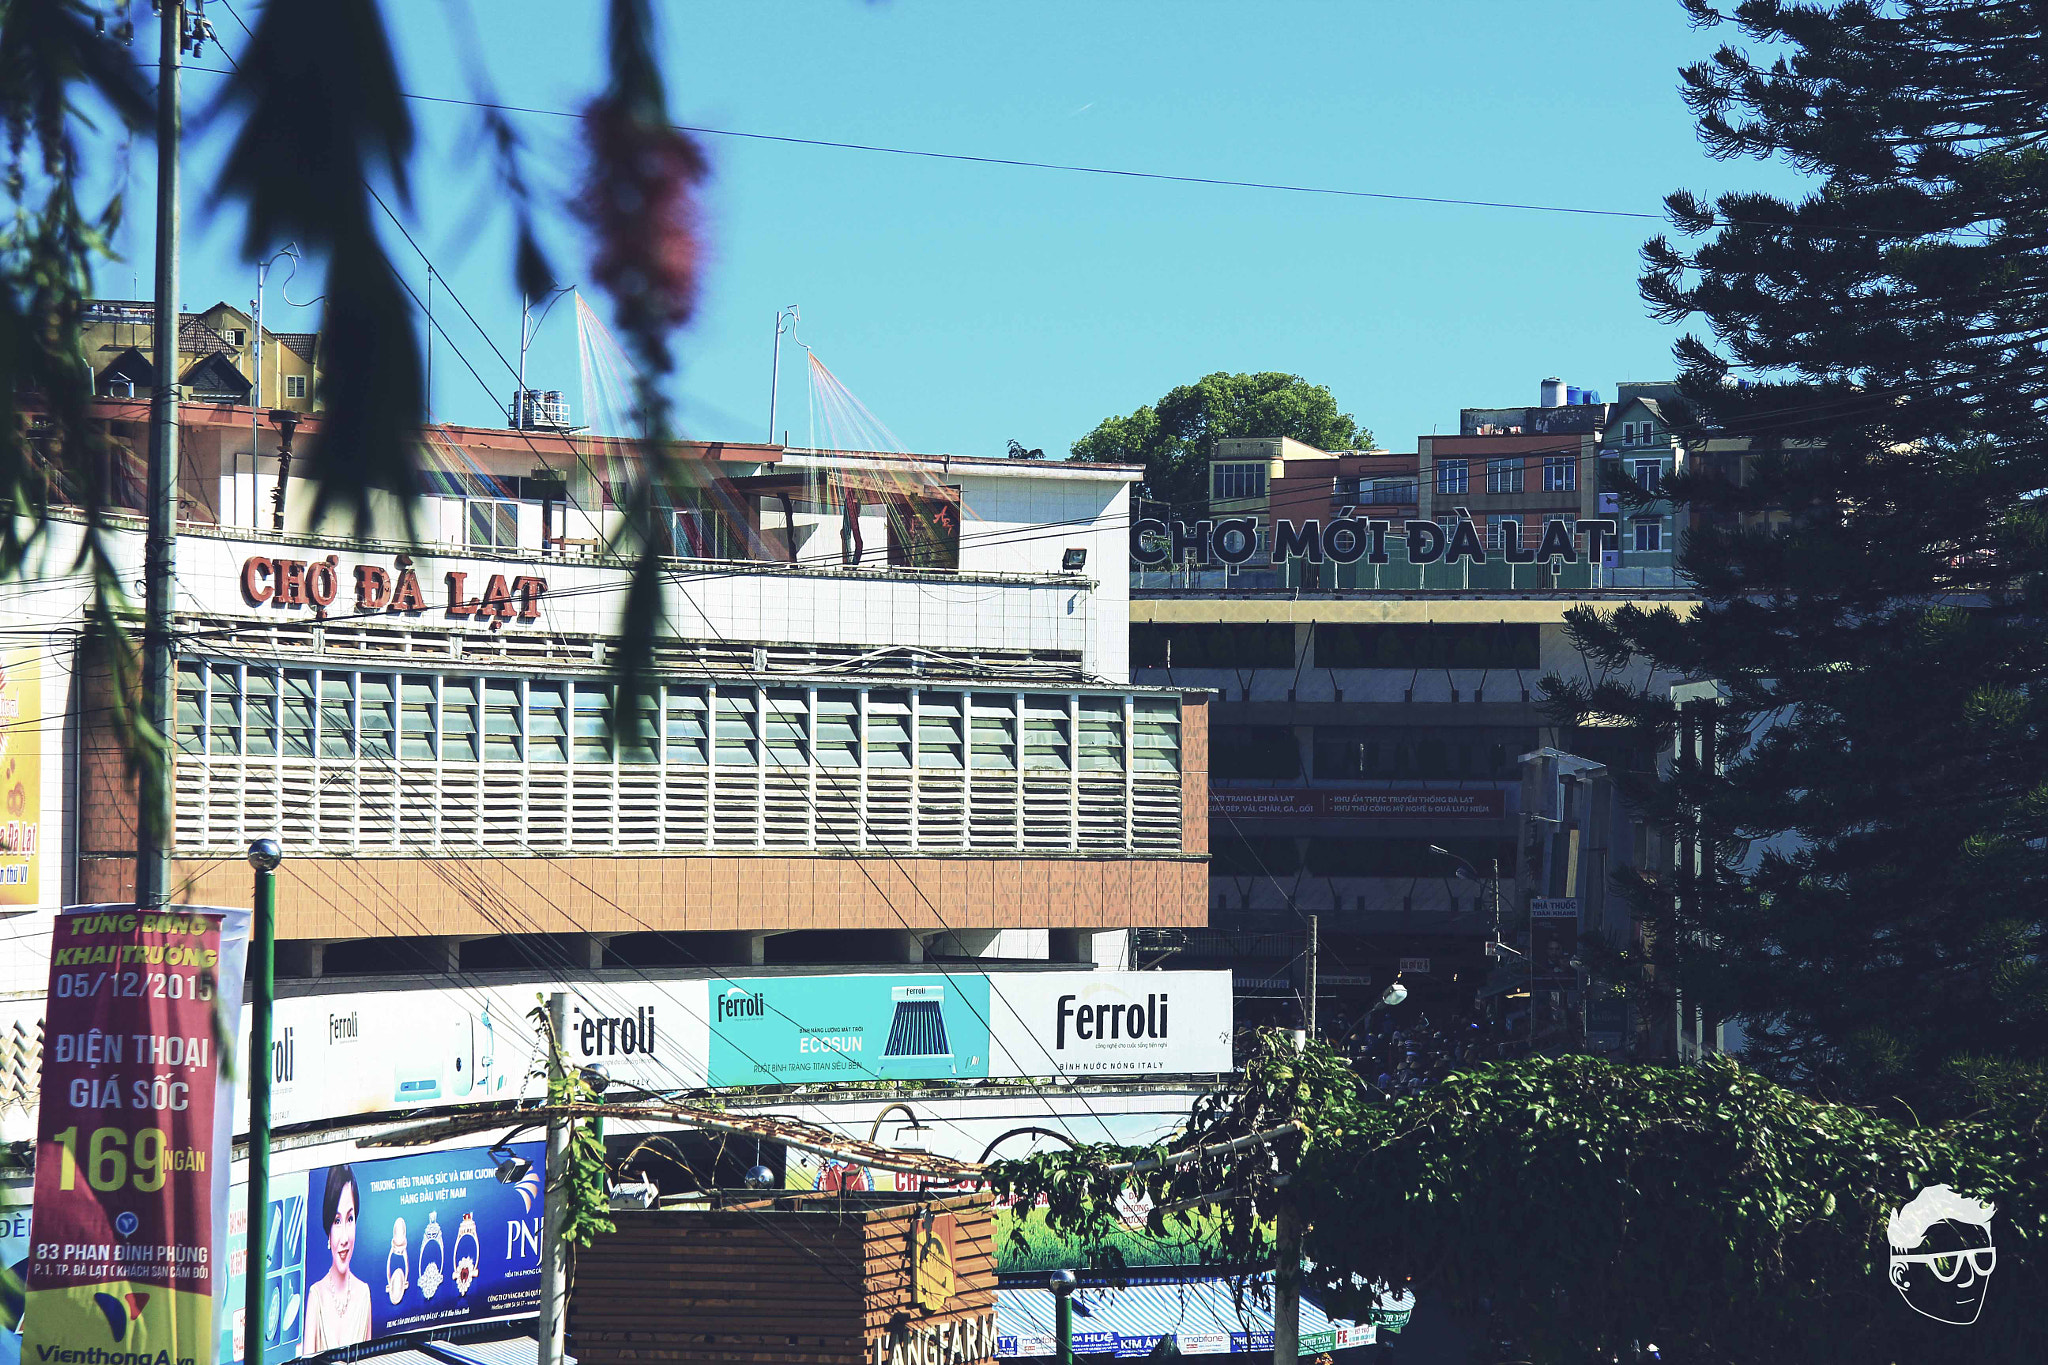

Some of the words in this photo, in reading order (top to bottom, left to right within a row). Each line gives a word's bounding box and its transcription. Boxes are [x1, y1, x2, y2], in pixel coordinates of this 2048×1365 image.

[1129, 516, 1258, 577] CHỢ
[1271, 505, 1391, 565] MỚI
[1404, 507, 1487, 565] ĐÀ
[1501, 519, 1617, 576] LẠT
[240, 554, 339, 620] CHỢ
[353, 553, 428, 615] ĐÀ
[444, 571, 549, 633] LẠT
[54, 945, 116, 967] KHAI
[121, 942, 218, 968] TRƯƠNG
[906, 987, 926, 996] Ferroli
[717, 993, 764, 1022] Ferroli
[329, 1011, 358, 1045] Ferroli
[1056, 993, 1168, 1050] Ferroli
[56, 1027, 123, 1069] ĐIỆN
[132, 1034, 209, 1073] THOẠI
[800, 1036, 862, 1053] ECOSUN
[813, 1061, 831, 1071] TITAN
[1110, 1060, 1135, 1070] NÓNG
[1138, 1061, 1164, 1069] ITALY
[70, 1073, 123, 1109] GIÁ
[132, 1072, 189, 1111] SỐC
[53, 1126, 168, 1192] 169
[164, 1145, 206, 1172] NGÀN
[412, 1174, 435, 1186] TRANG
[448, 1170, 459, 1182] VÀ
[459, 1170, 474, 1182] KIM
[400, 1191, 419, 1206] HÀNG
[419, 1187, 434, 1203] ĐẦU
[450, 1187, 467, 1199] NAM
[36, 1243, 59, 1260] 83
[64, 1243, 111, 1261] PHAN
[113, 1241, 153, 1261] ĐÌNH
[157, 1243, 208, 1264] PHÙNG
[506, 1216, 544, 1267] PNJ
[73, 1262, 87, 1276] ĐÀ
[89, 1264, 109, 1279] LẠT
[1121, 1339, 1142, 1350] KIM
